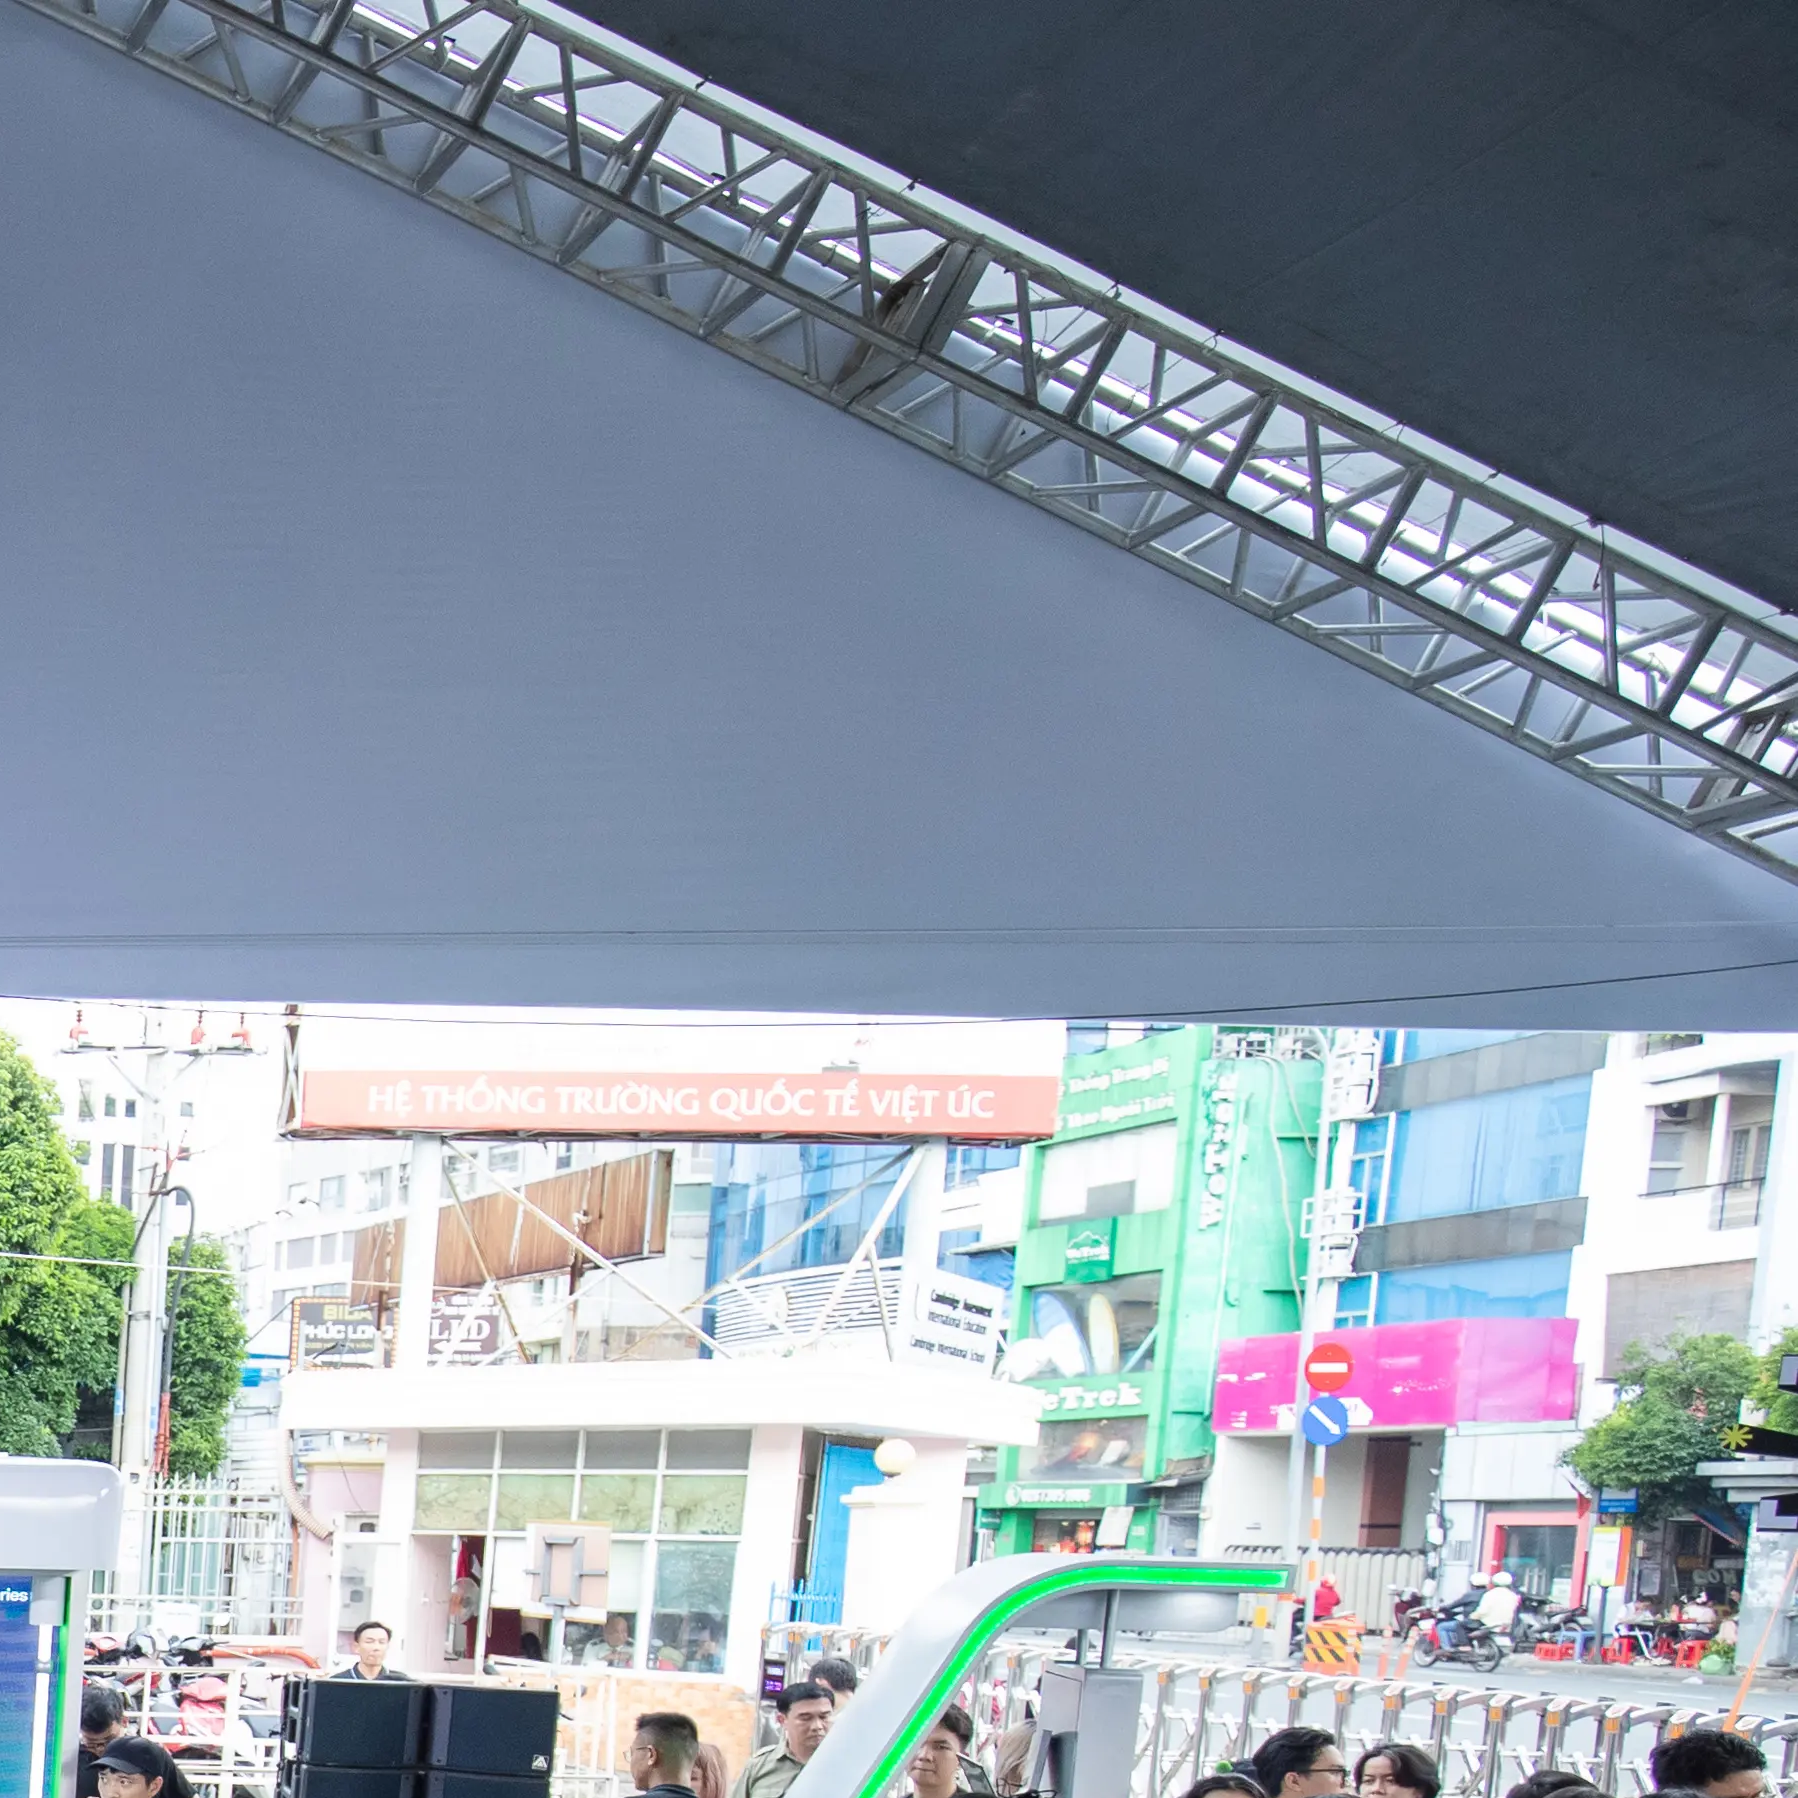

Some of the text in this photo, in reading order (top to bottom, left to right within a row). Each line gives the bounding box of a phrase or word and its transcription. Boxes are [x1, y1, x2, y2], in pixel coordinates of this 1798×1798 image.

[368, 1074, 995, 1124] HỆ THỐNG TRƯỜNG QUỐC TẾ VIỆT ÚC
[1039, 1382, 1141, 1410] eTrek
